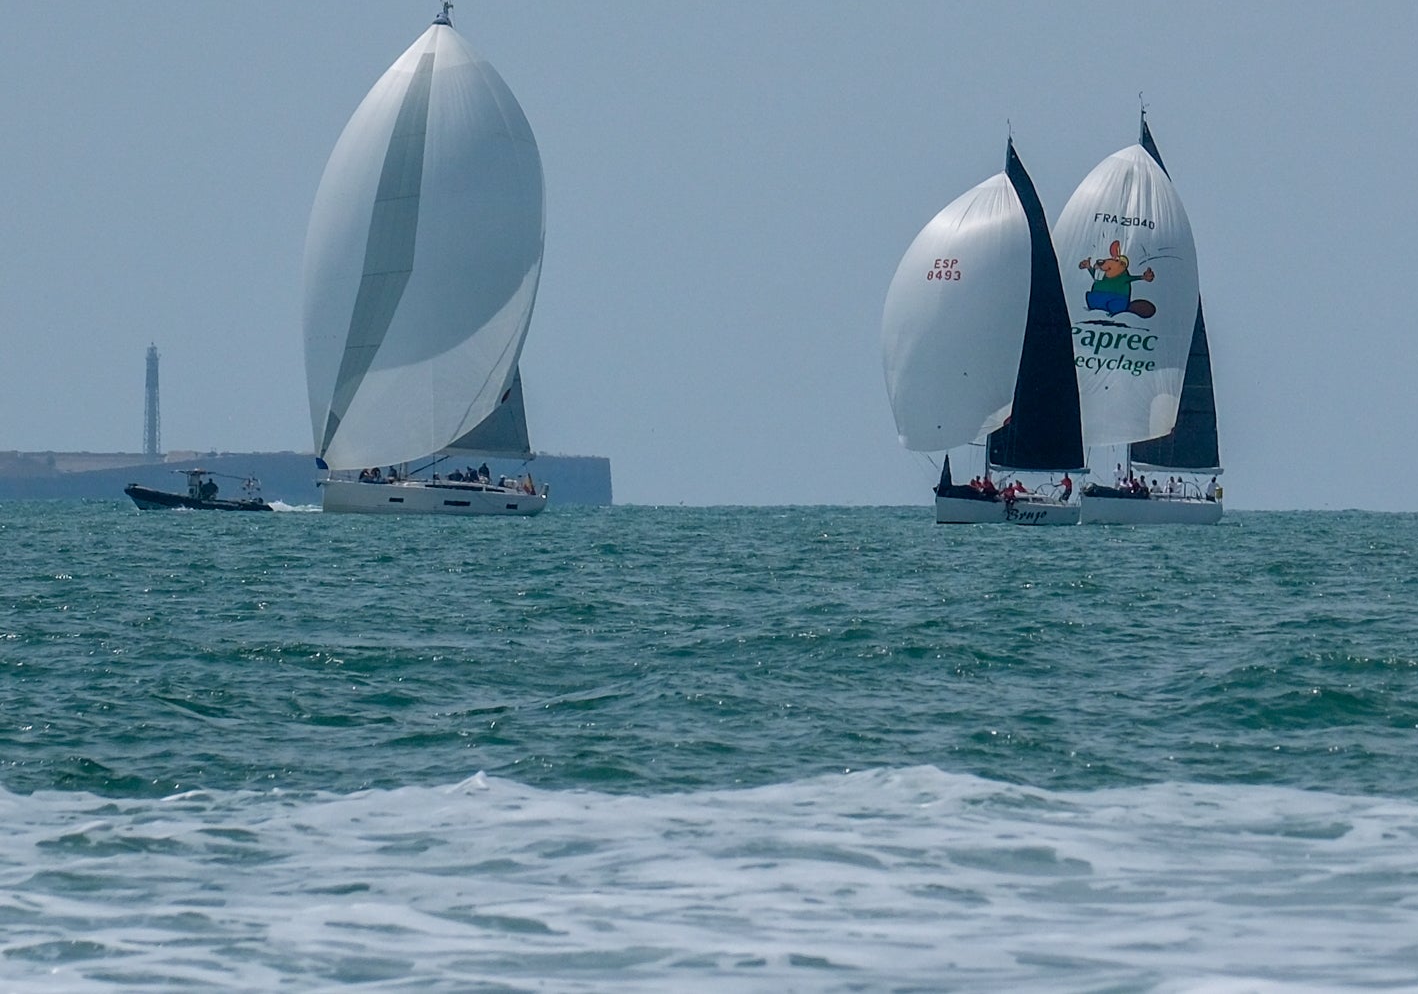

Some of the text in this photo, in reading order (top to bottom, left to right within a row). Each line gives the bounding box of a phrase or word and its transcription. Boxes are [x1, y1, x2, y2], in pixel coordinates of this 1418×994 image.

[1094, 213, 1118, 224] FRA
[934, 258, 959, 269] ESP
[1073, 354, 1156, 377] ecyclage
